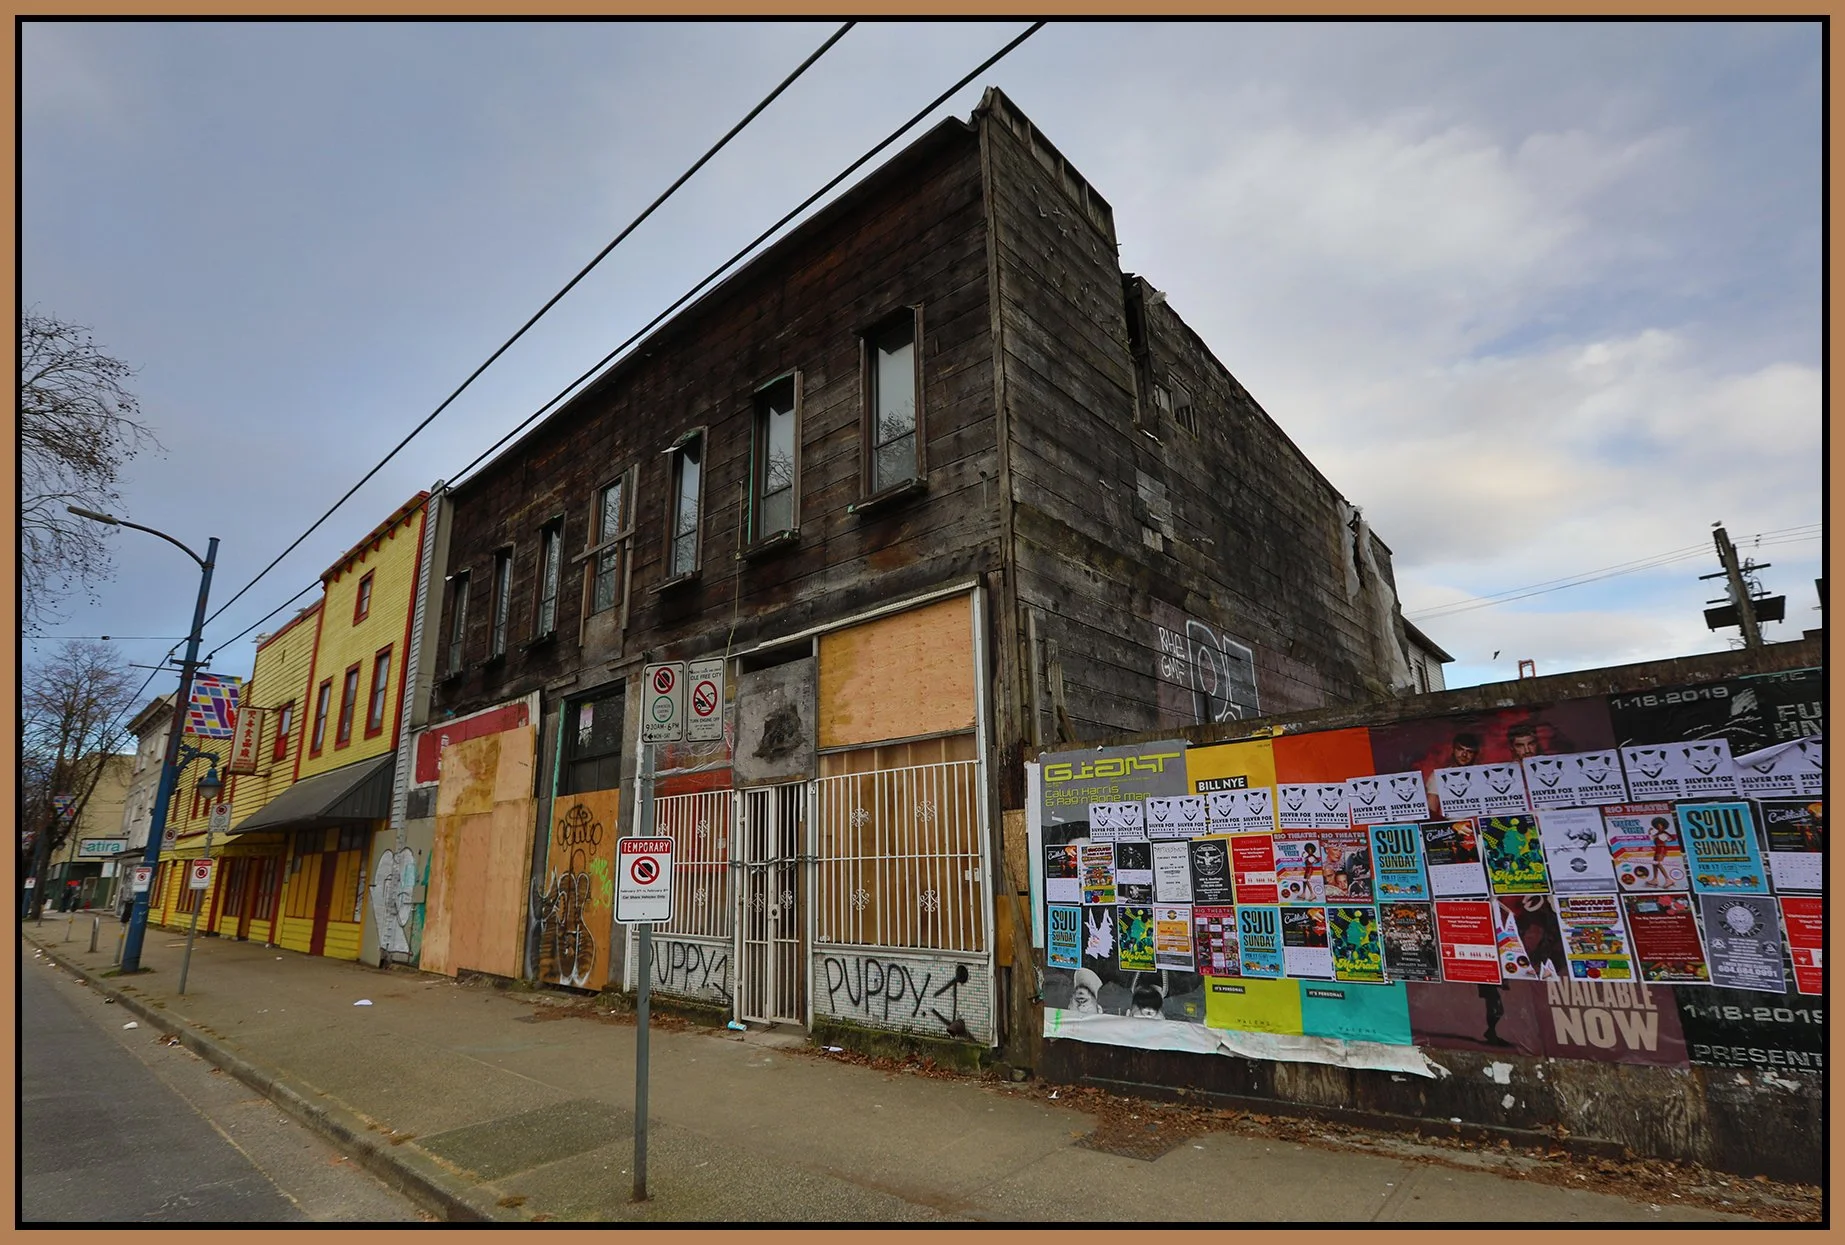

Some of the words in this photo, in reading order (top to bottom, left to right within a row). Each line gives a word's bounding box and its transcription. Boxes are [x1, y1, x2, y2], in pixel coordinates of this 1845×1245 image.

[1611, 687, 1729, 710] 1-18-2019
[1198, 780, 1222, 791] BILL
[1223, 778, 1245, 789] NYE
[1632, 779, 1660, 788] SILVER
[1661, 778, 1679, 786] FOX
[1684, 776, 1714, 785] SILVER
[1716, 775, 1734, 783] FOX
[1740, 776, 1773, 784] SILVER
[1774, 774, 1793, 782] FOX
[1081, 785, 1119, 796] Harris
[1532, 789, 1557, 797] SILVER
[1124, 792, 1151, 801] Man
[1626, 804, 1669, 812] THEATRE
[86, 841, 120, 852] atira
[623, 842, 669, 853] TEMPORARY
[1693, 840, 1746, 856] SUNDAY
[1379, 855, 1416, 868] SUNDAY
[1052, 931, 1076, 943] SUNDAY
[1244, 935, 1275, 948] SUNDAY
[1548, 979, 1658, 1010] AVAILABLE
[1551, 1007, 1659, 1051] NOW
